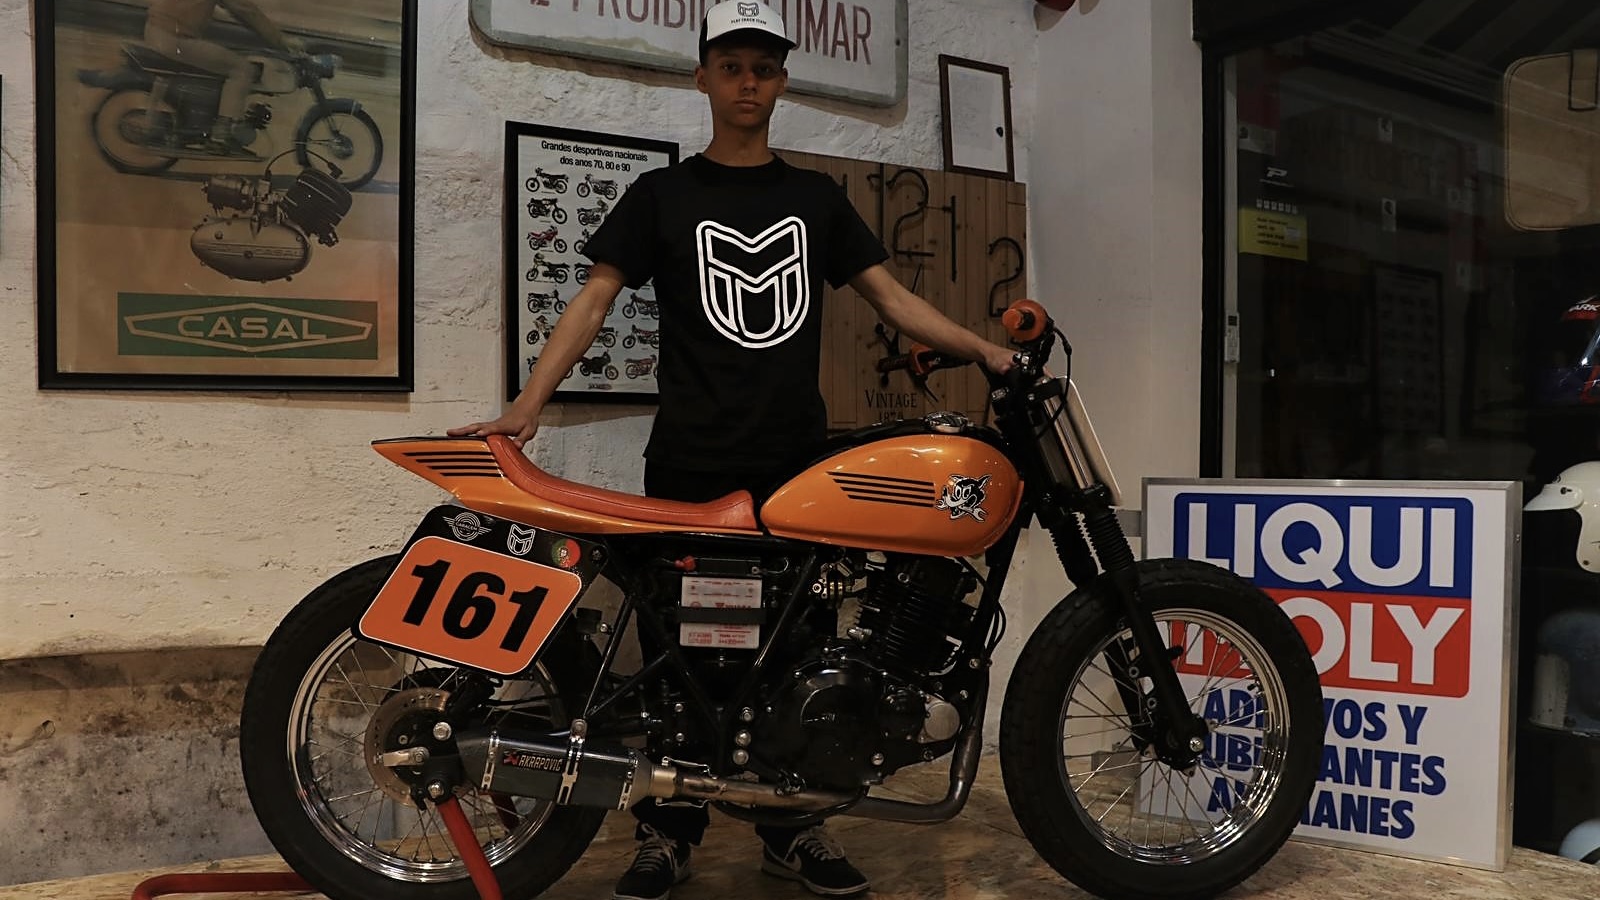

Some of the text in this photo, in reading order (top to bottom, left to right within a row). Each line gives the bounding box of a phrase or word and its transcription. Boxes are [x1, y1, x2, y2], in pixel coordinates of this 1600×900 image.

[766, 0, 873, 65] UMAR
[541, 140, 648, 161] Grandes desportivas nacionais
[560, 156, 573, 165] dos
[575, 158, 592, 167] anos
[605, 161, 614, 170] 80
[621, 163, 631, 171] 90
[177, 316, 327, 341] CASAL
[1189, 502, 1456, 588] LIQUI
[402, 559, 549, 653] 161
[1204, 688, 1428, 745] ADIOS Y
